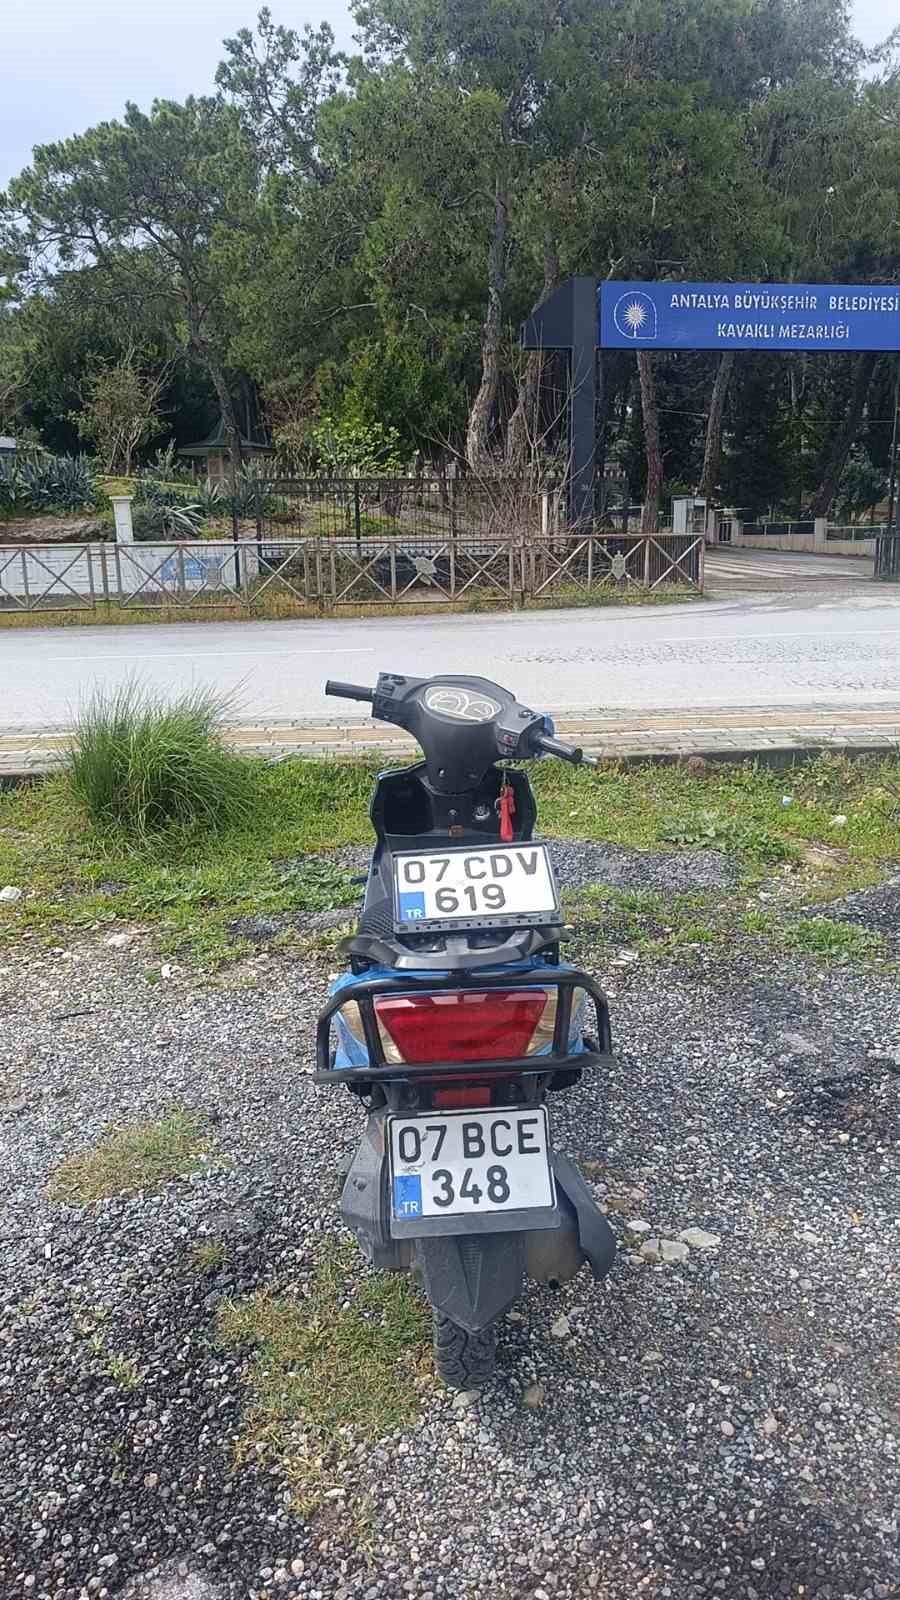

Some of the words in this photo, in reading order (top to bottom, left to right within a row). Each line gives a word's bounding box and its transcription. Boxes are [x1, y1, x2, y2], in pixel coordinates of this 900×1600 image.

[670, 294, 730, 309] ANTALYA
[734, 290, 817, 313] BÜYÜKŞEHİR
[829, 292, 899, 311] BELEDİYESİ
[717, 323, 774, 338] KAVAKLI
[778, 321, 849, 338] MEZARLIĞI
[403, 858, 450, 884] 07
[463, 852, 538, 879] CDV
[435, 884, 506, 912] 619
[405, 908, 423, 918] TR
[399, 1125, 447, 1163] 07
[462, 1118, 541, 1159] BCE
[431, 1165, 511, 1207] 348
[402, 1201, 418, 1213] TR
